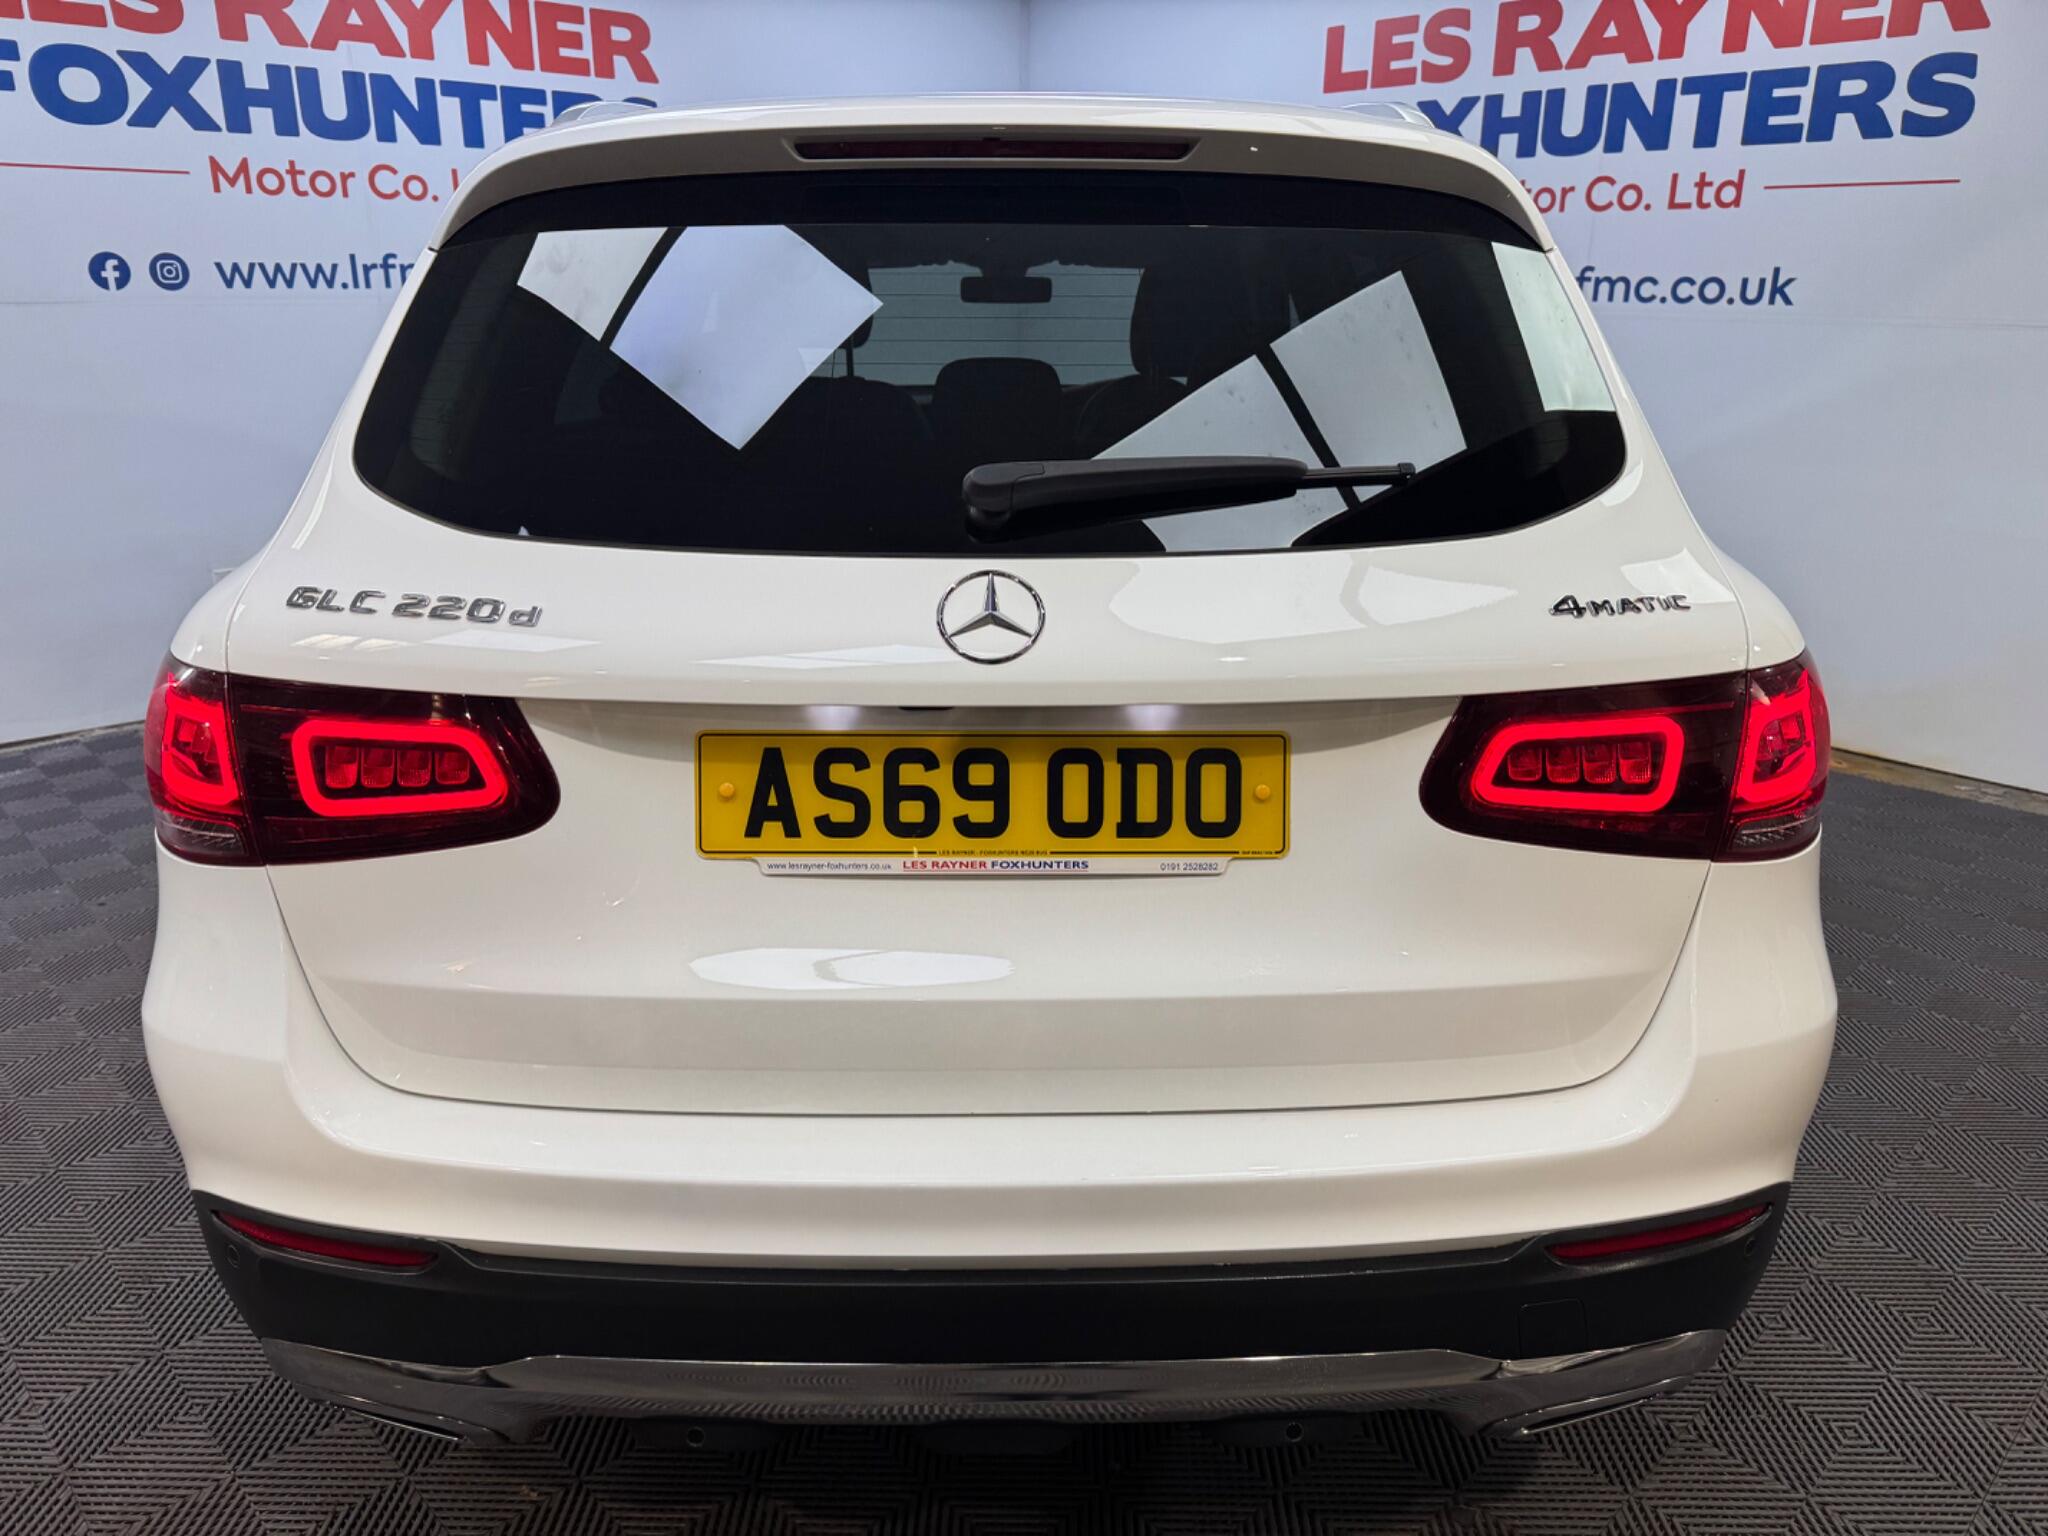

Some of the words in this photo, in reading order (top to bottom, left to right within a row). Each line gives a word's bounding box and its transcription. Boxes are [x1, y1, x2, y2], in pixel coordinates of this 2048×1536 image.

[1323, 8, 1471, 94] LES
[0, 38, 658, 149] OXHUNTE
[208, 155, 356, 199] Motor
[368, 163, 439, 202] Co.
[1585, 175, 1652, 213] Co.
[1667, 169, 1746, 210] Ltd
[286, 586, 386, 615] GLC
[743, 747, 1010, 839] AS69
[1047, 747, 1243, 839] ODO
[903, 860, 928, 870] LES
[931, 860, 987, 870] RAYNER
[991, 859, 1089, 870] FOXHUNTERS
[1160, 863, 1181, 871] 0191
